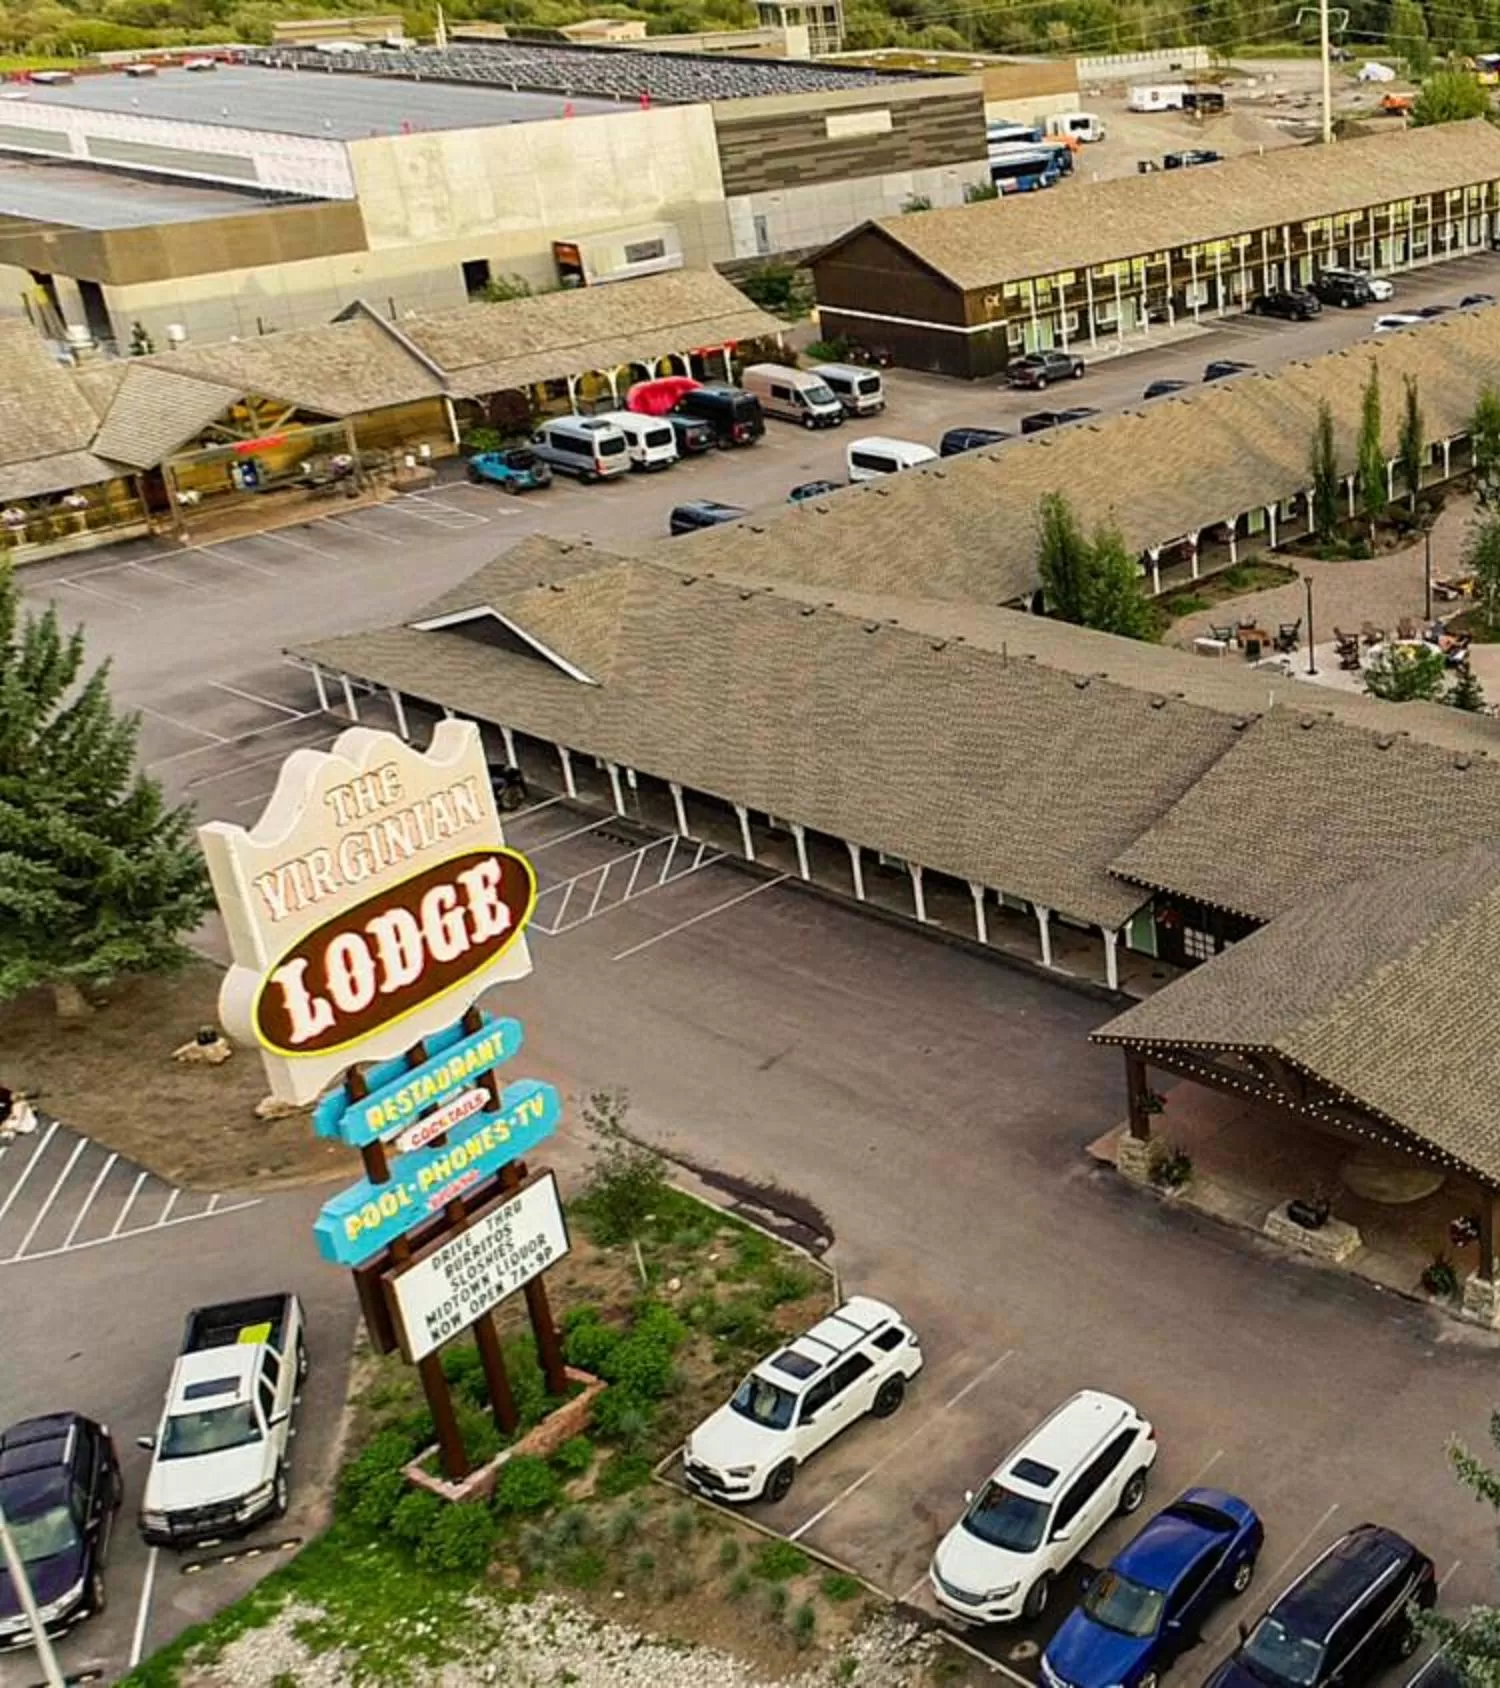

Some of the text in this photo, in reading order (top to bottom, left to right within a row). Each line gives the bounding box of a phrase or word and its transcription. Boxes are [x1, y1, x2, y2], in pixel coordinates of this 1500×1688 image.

[325, 761, 403, 826] THE
[253, 775, 486, 922] VIRGINIAN
[271, 857, 512, 1044] LODGE
[365, 1031, 505, 1131] RESTAURANT
[411, 1093, 485, 1146] COCKTAILS
[344, 1184, 413, 1240] POOL
[417, 1119, 511, 1192] PHONES
[514, 1092, 545, 1126] TV
[425, 1233, 547, 1328] MIDTOWN LIQUOR
[431, 1199, 523, 1271] DRIVE THRU
[444, 1224, 513, 1279] BURRITOS
[450, 1238, 514, 1292] SLOSHIES
[431, 1246, 553, 1342] NOW OPEN 7A-9P
